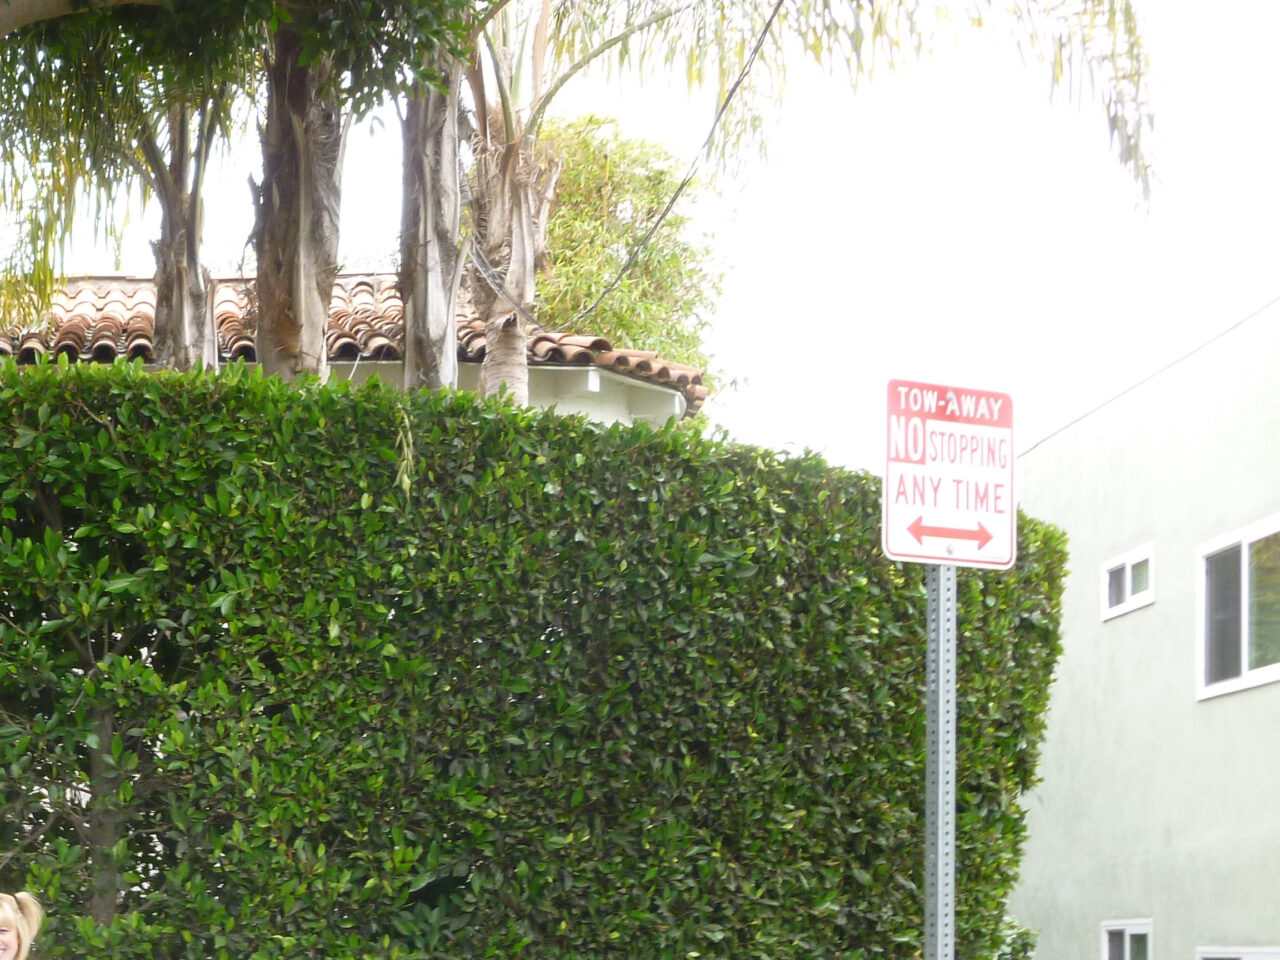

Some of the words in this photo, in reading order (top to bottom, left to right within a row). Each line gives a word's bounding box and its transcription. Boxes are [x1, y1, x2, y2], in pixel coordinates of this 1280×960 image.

[897, 386, 1003, 421] TOW-AWAY
[890, 414, 925, 461] NO
[929, 431, 1007, 469] STOPPING
[895, 473, 942, 508] ANY
[952, 479, 1005, 514] TIME
